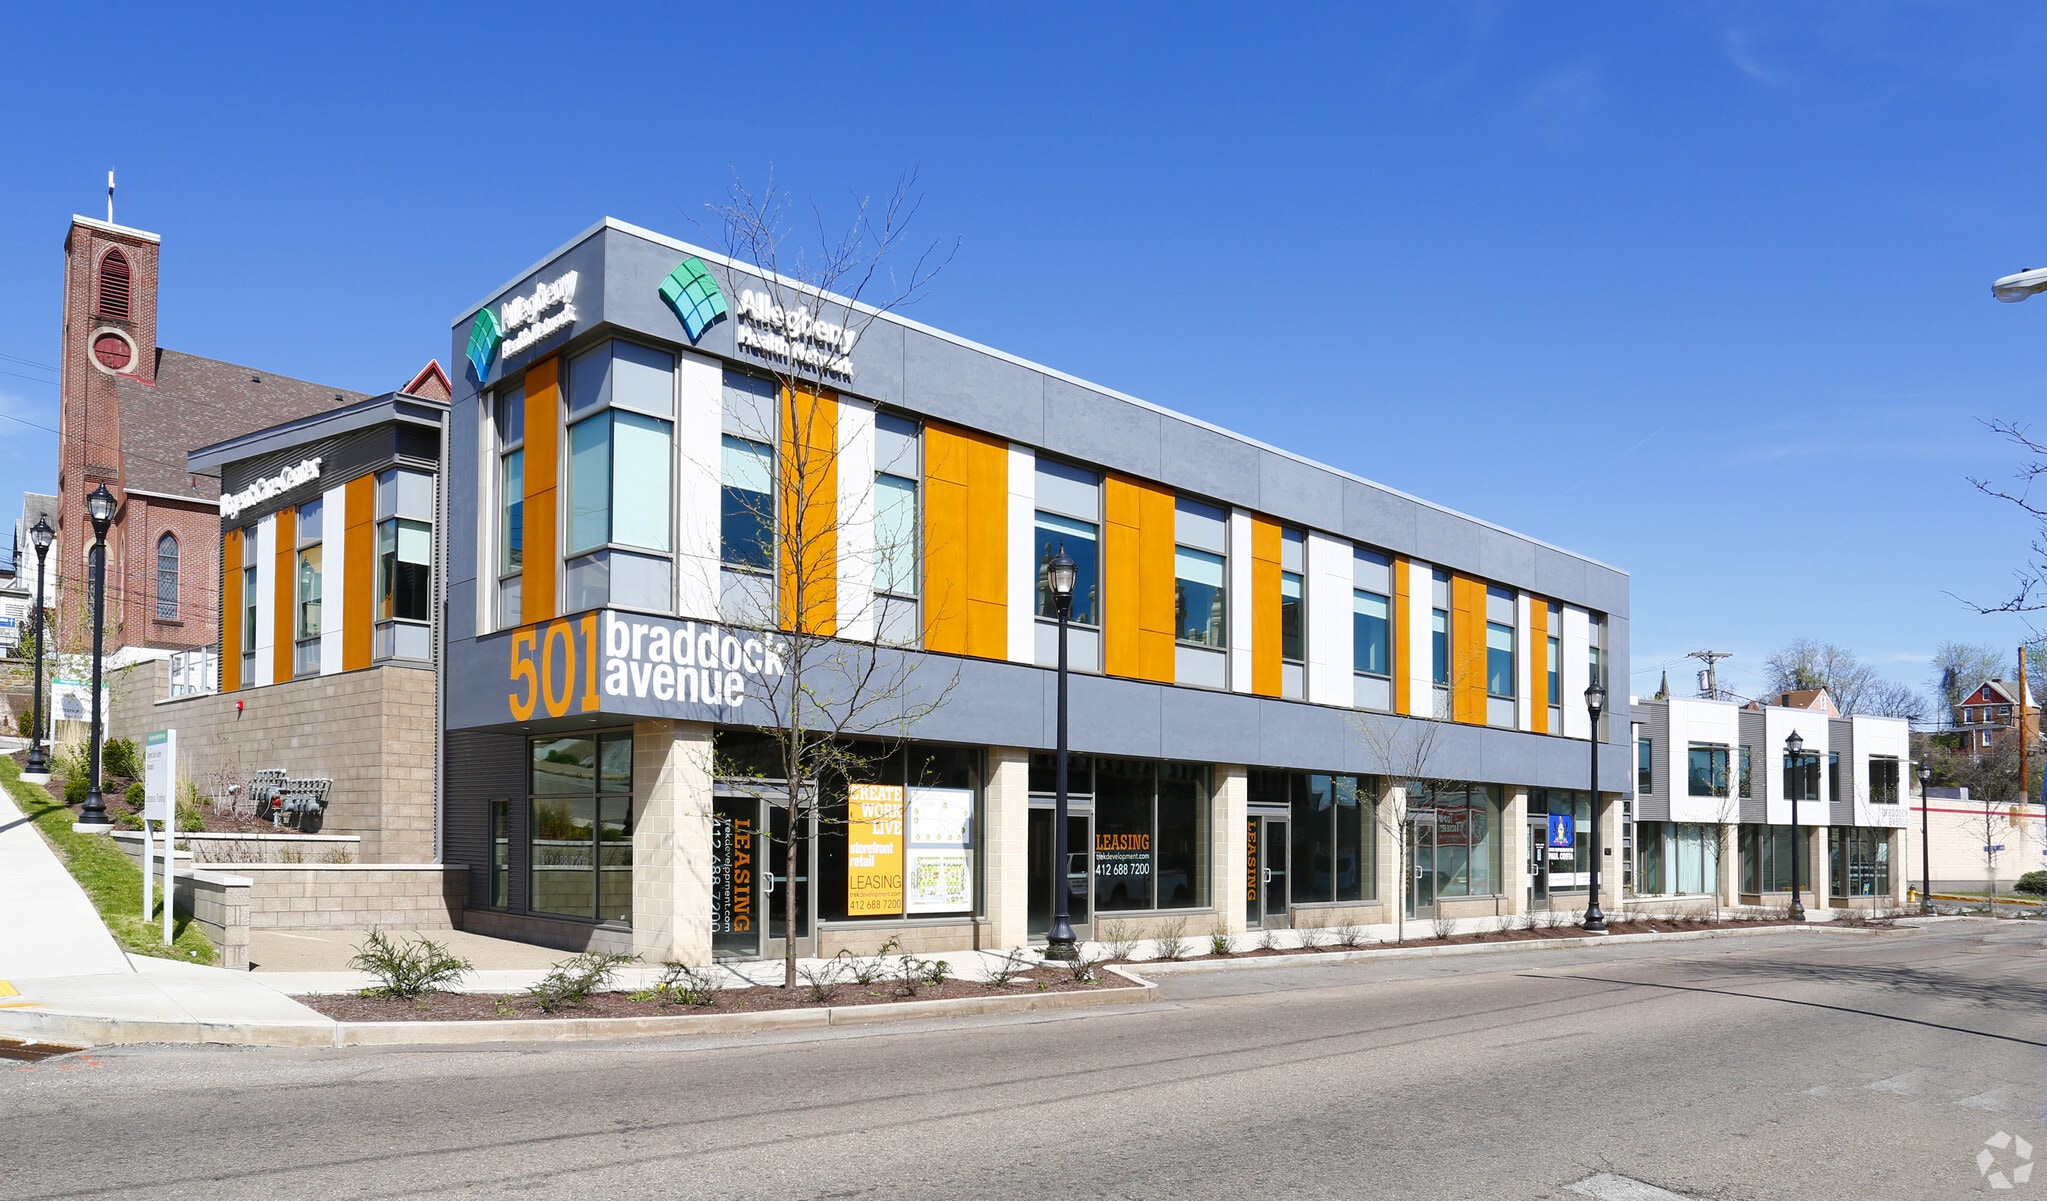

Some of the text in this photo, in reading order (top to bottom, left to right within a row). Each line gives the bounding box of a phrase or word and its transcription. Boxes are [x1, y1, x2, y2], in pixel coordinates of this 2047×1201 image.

[501, 269, 578, 333] Allegheny
[737, 289, 856, 357] Allegheny
[737, 325, 854, 376] Health Network
[605, 609, 786, 676] braddock
[509, 610, 600, 722] 501
[604, 658, 745, 708] avenue
[850, 785, 902, 801] CREATE
[861, 803, 902, 818] WORK
[872, 820, 902, 835] LIVE
[850, 842, 894, 854] storefront
[1096, 834, 1150, 850] LEASING
[850, 855, 875, 867] retail
[1096, 852, 1150, 861] trekdevelopment.com
[1248, 821, 1257, 901] LEASING
[723, 818, 733, 932] trekdevelopment.com
[734, 819, 751, 932] LEASING
[1096, 863, 1150, 876] 412 688 7200
[850, 875, 901, 890] LEASING
[850, 899, 901, 910] 412 688 7200
